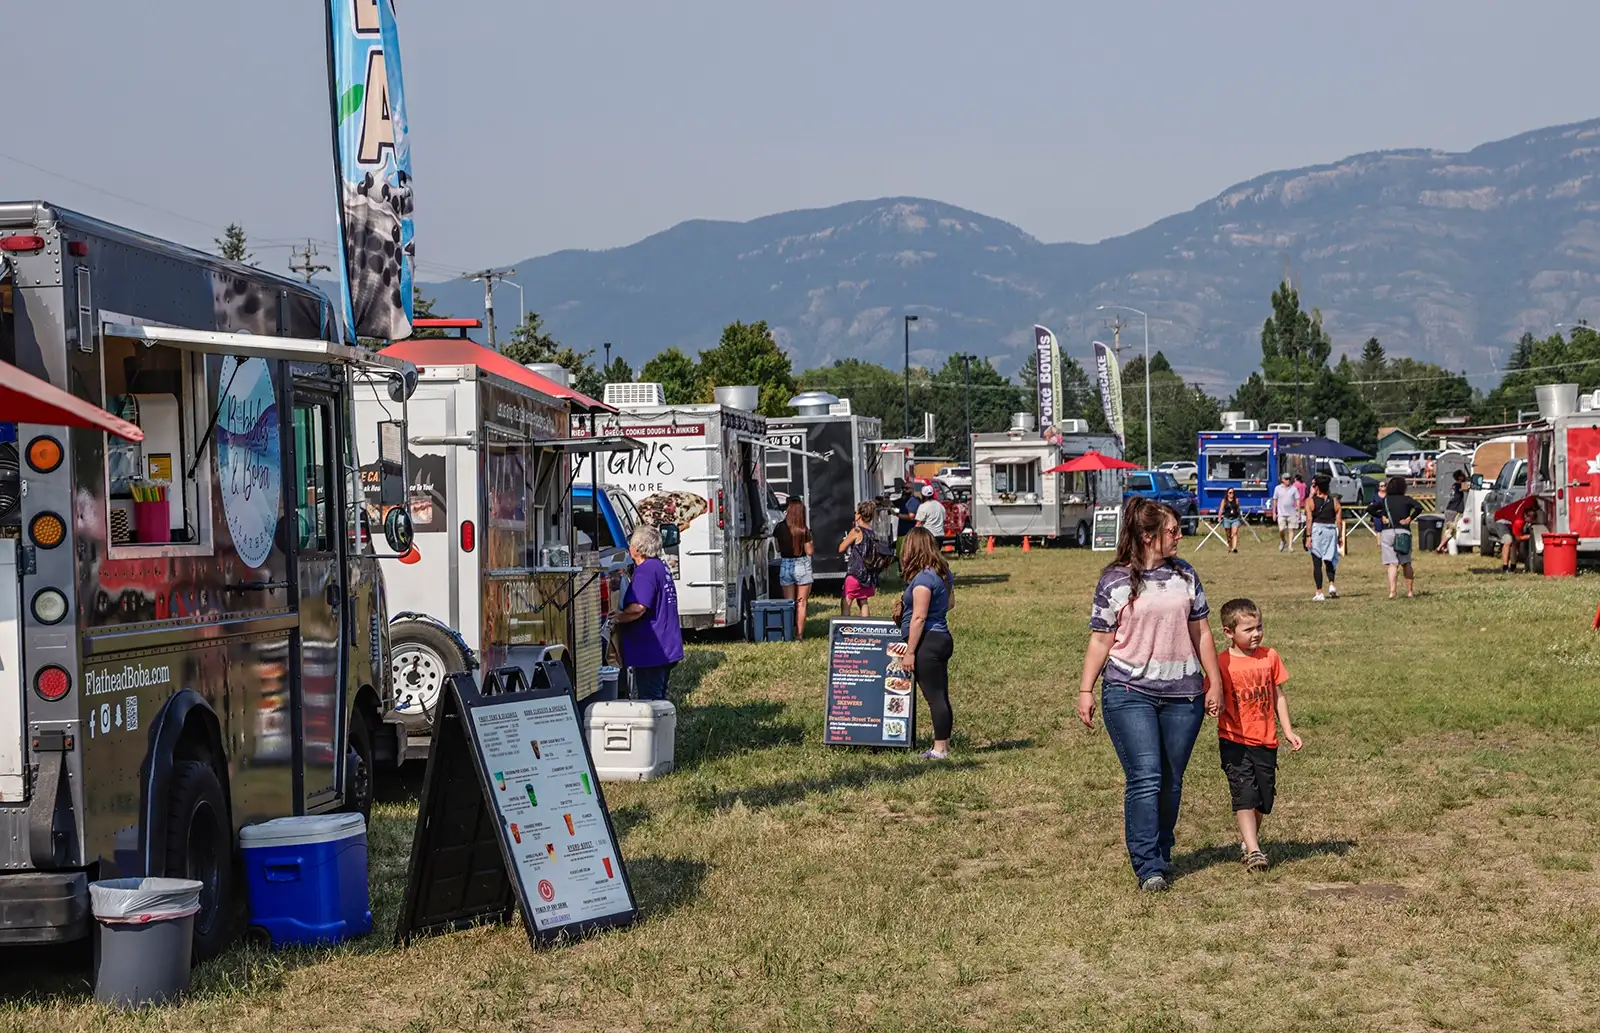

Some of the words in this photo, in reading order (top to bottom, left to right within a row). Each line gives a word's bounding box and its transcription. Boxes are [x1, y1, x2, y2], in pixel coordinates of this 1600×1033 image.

[243, 447, 270, 501] Boba
[607, 441, 675, 476] GUYS
[628, 482, 663, 492] MORE
[85, 663, 170, 696] FlatheadBoba.com
